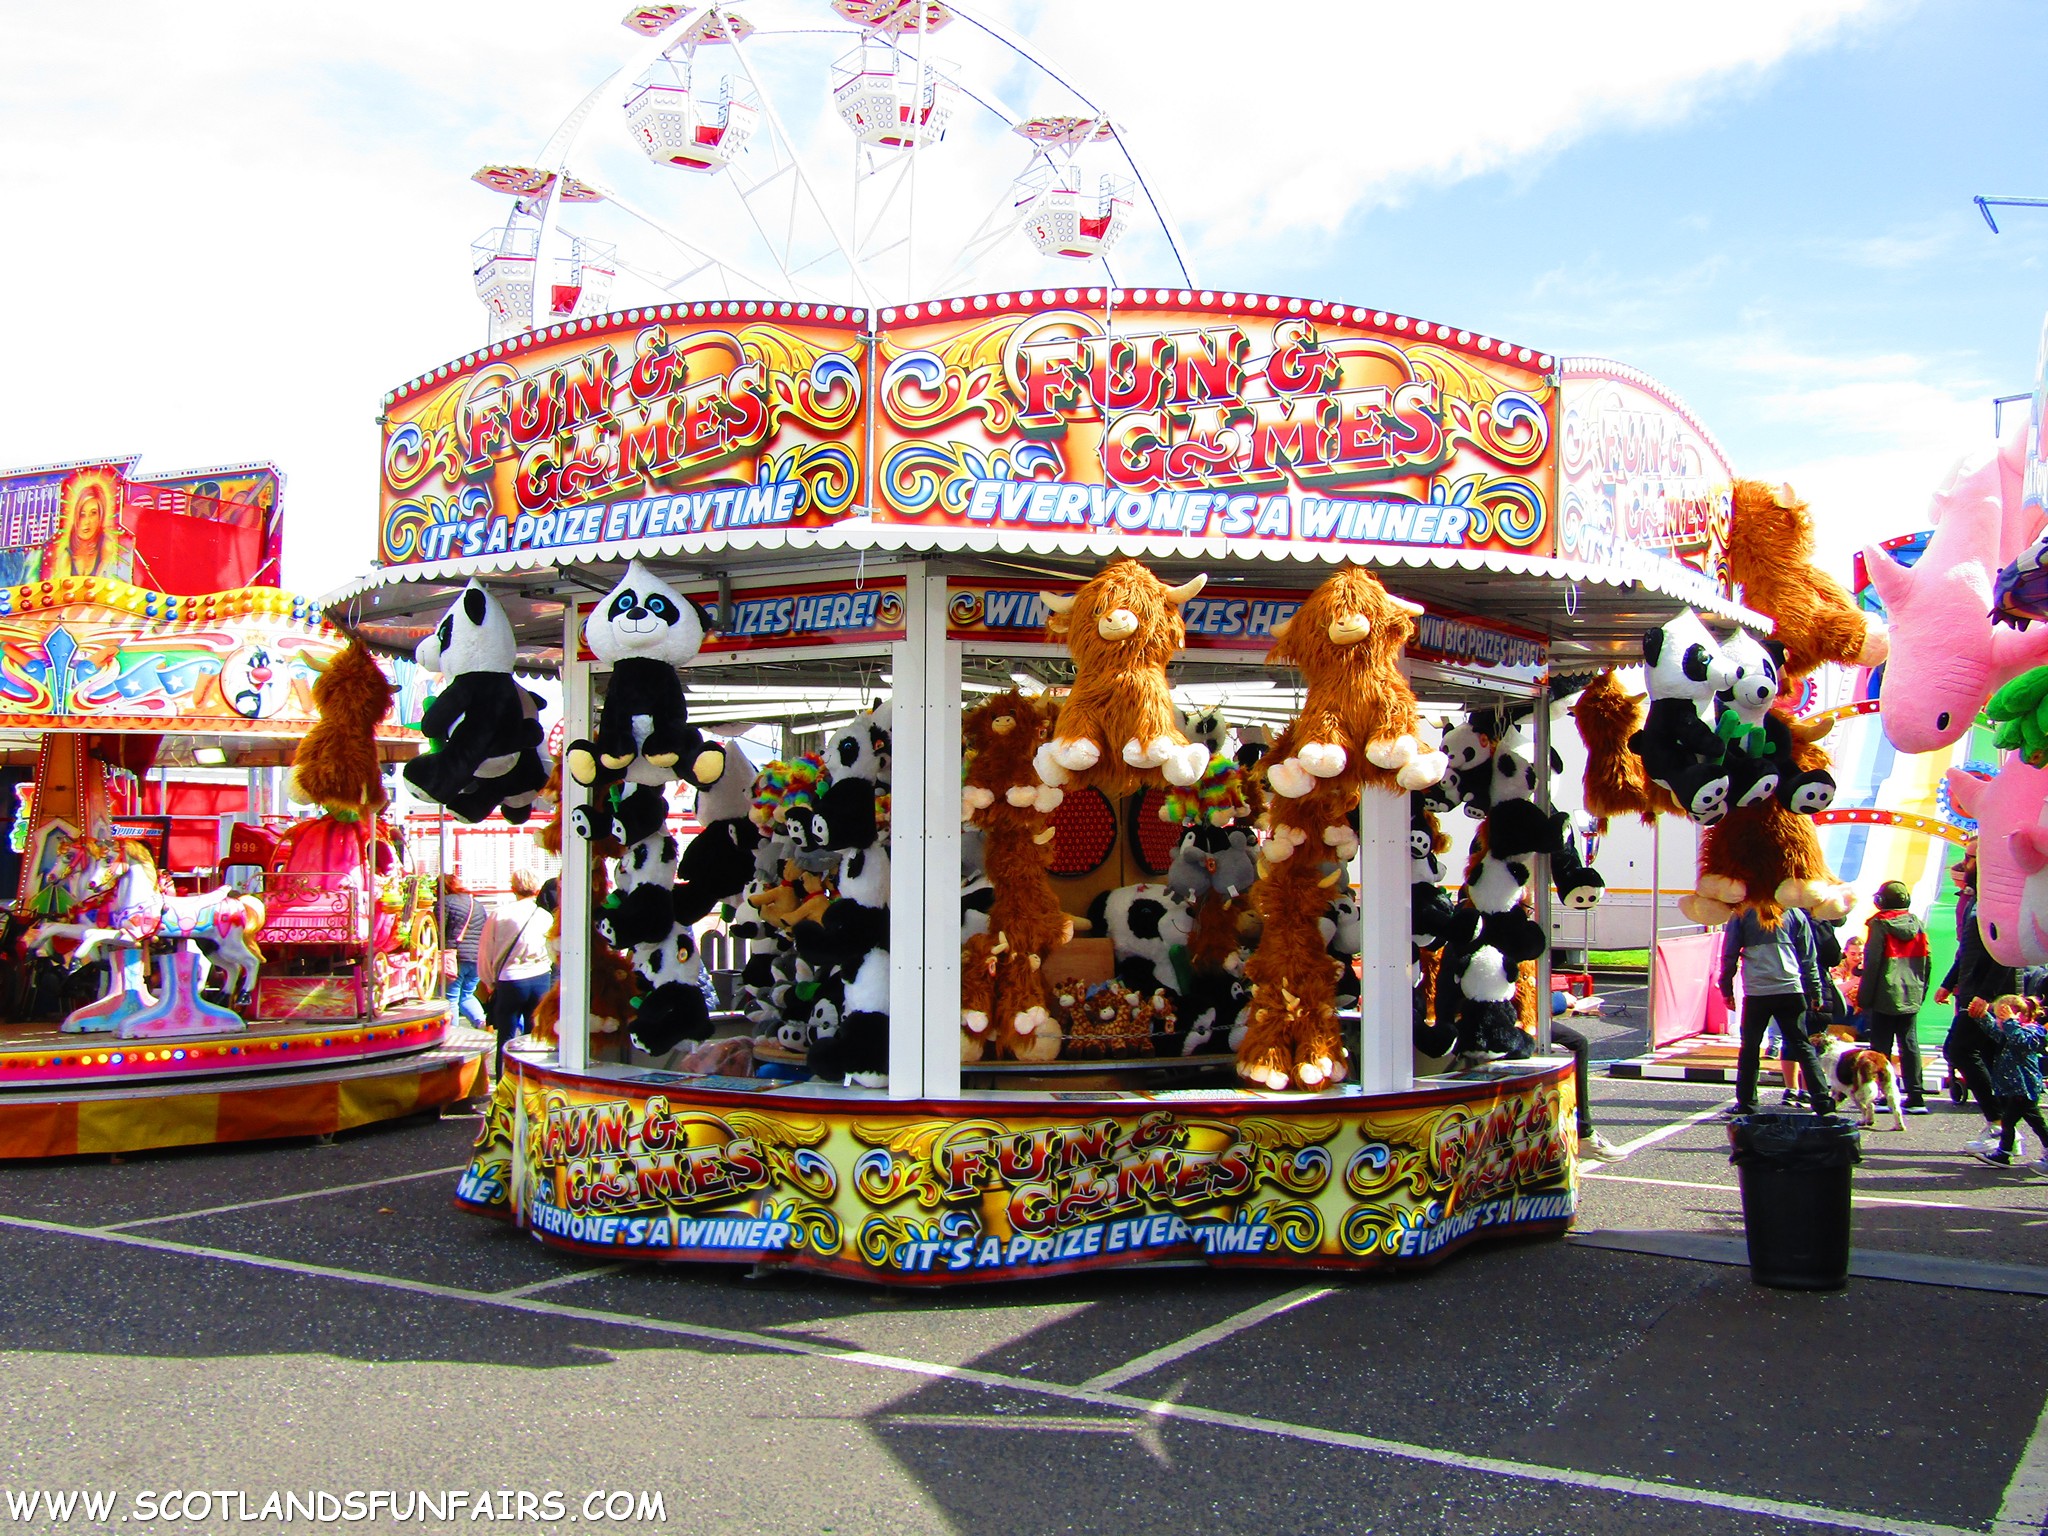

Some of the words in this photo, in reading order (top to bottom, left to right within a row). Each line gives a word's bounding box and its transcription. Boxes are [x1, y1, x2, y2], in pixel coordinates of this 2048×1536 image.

[643, 128, 653, 143] 3
[855, 112, 865, 126] 4
[1036, 226, 1046, 239] 5
[463, 345, 616, 475] FUN
[627, 324, 688, 400] &
[1013, 325, 1249, 429] FUN
[1264, 317, 1342, 395] &
[515, 359, 769, 515] GAMES
[1103, 380, 1448, 493] GAMES
[427, 516, 483, 560] IT'S
[485, 521, 508, 554] A
[512, 506, 602, 550] PRIZE
[604, 482, 801, 542] EVERYTIME
[967, 480, 1258, 535] EVERYONE'S
[1254, 494, 1290, 536] A
[1299, 500, 1472, 545] WINNER
[703, 600, 793, 637] IZES
[794, 592, 881, 632] HERE!
[984, 591, 1050, 627] WIN
[1419, 616, 1444, 648] WIN
[1445, 621, 1468, 653] BIG
[1468, 627, 1508, 662] PRIZES
[543, 1100, 633, 1168] FUN
[642, 1096, 687, 1149] &
[943, 1118, 1120, 1201] FUN
[1131, 1111, 1190, 1150] &
[1431, 1095, 1523, 1191] FUN
[566, 1136, 770, 1218] GAMES
[1006, 1141, 1258, 1239] GAMES
[531, 1200, 648, 1247] EVERYONE'S
[648, 1218, 671, 1247] A
[678, 1218, 790, 1250] WINNER
[903, 1237, 976, 1272] IT'S
[975, 1242, 1002, 1268] A
[1005, 1225, 1104, 1266] PRIZE
[1106, 1214, 1270, 1253] EVERYTIME
[1497, 1198, 1513, 1225] A
